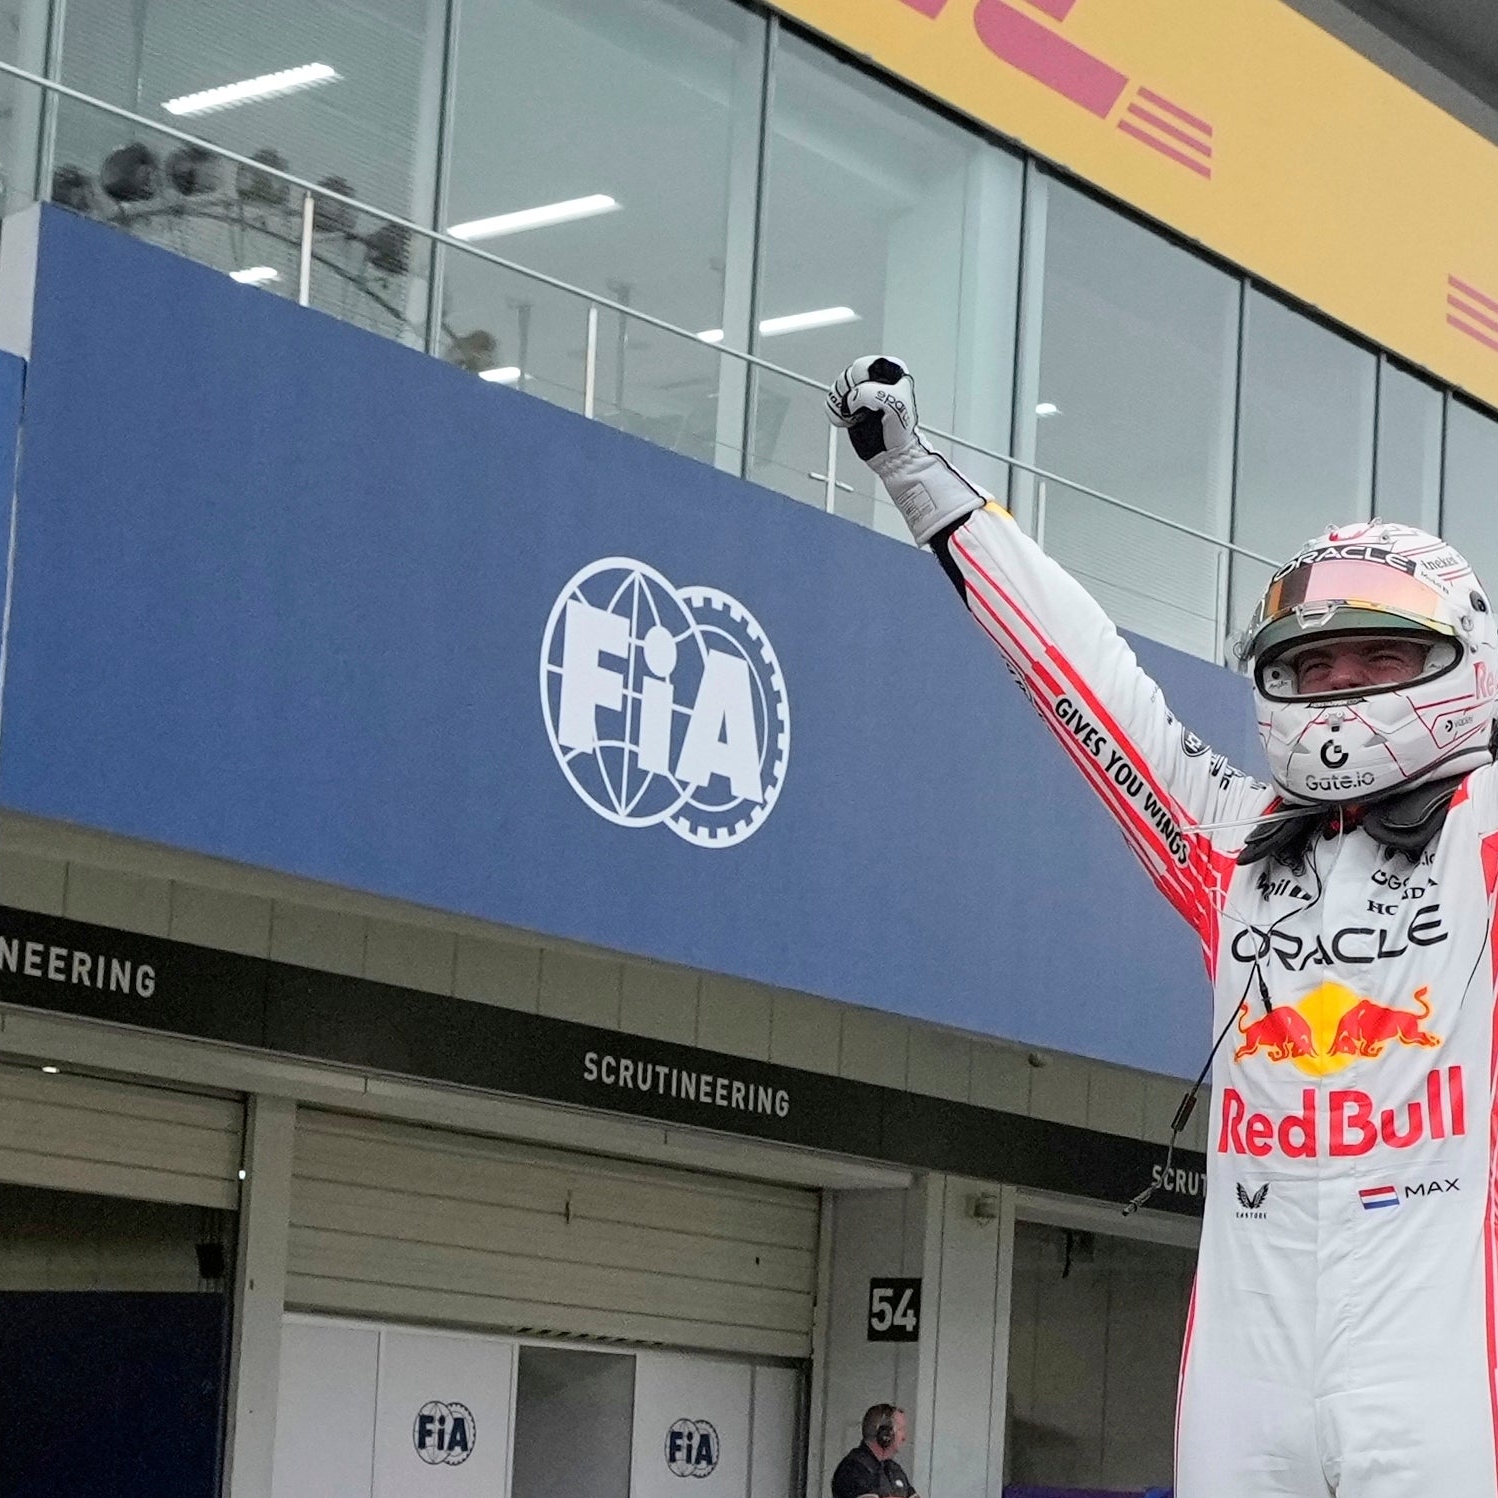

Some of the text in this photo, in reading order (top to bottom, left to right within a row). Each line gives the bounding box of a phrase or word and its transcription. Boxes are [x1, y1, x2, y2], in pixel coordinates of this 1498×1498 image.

[1272, 546, 1409, 582] ORACLE
[1054, 697, 1189, 865] GIVES YOU WINGS
[1305, 771, 1375, 791] Gate.io
[1231, 903, 1449, 972] ORACLE
[584, 1050, 791, 1118] SCRUTINEERING
[1217, 1065, 1466, 1159] Red Bull
[1404, 1177, 1461, 1199] MAX
[871, 1286, 917, 1332] 54
